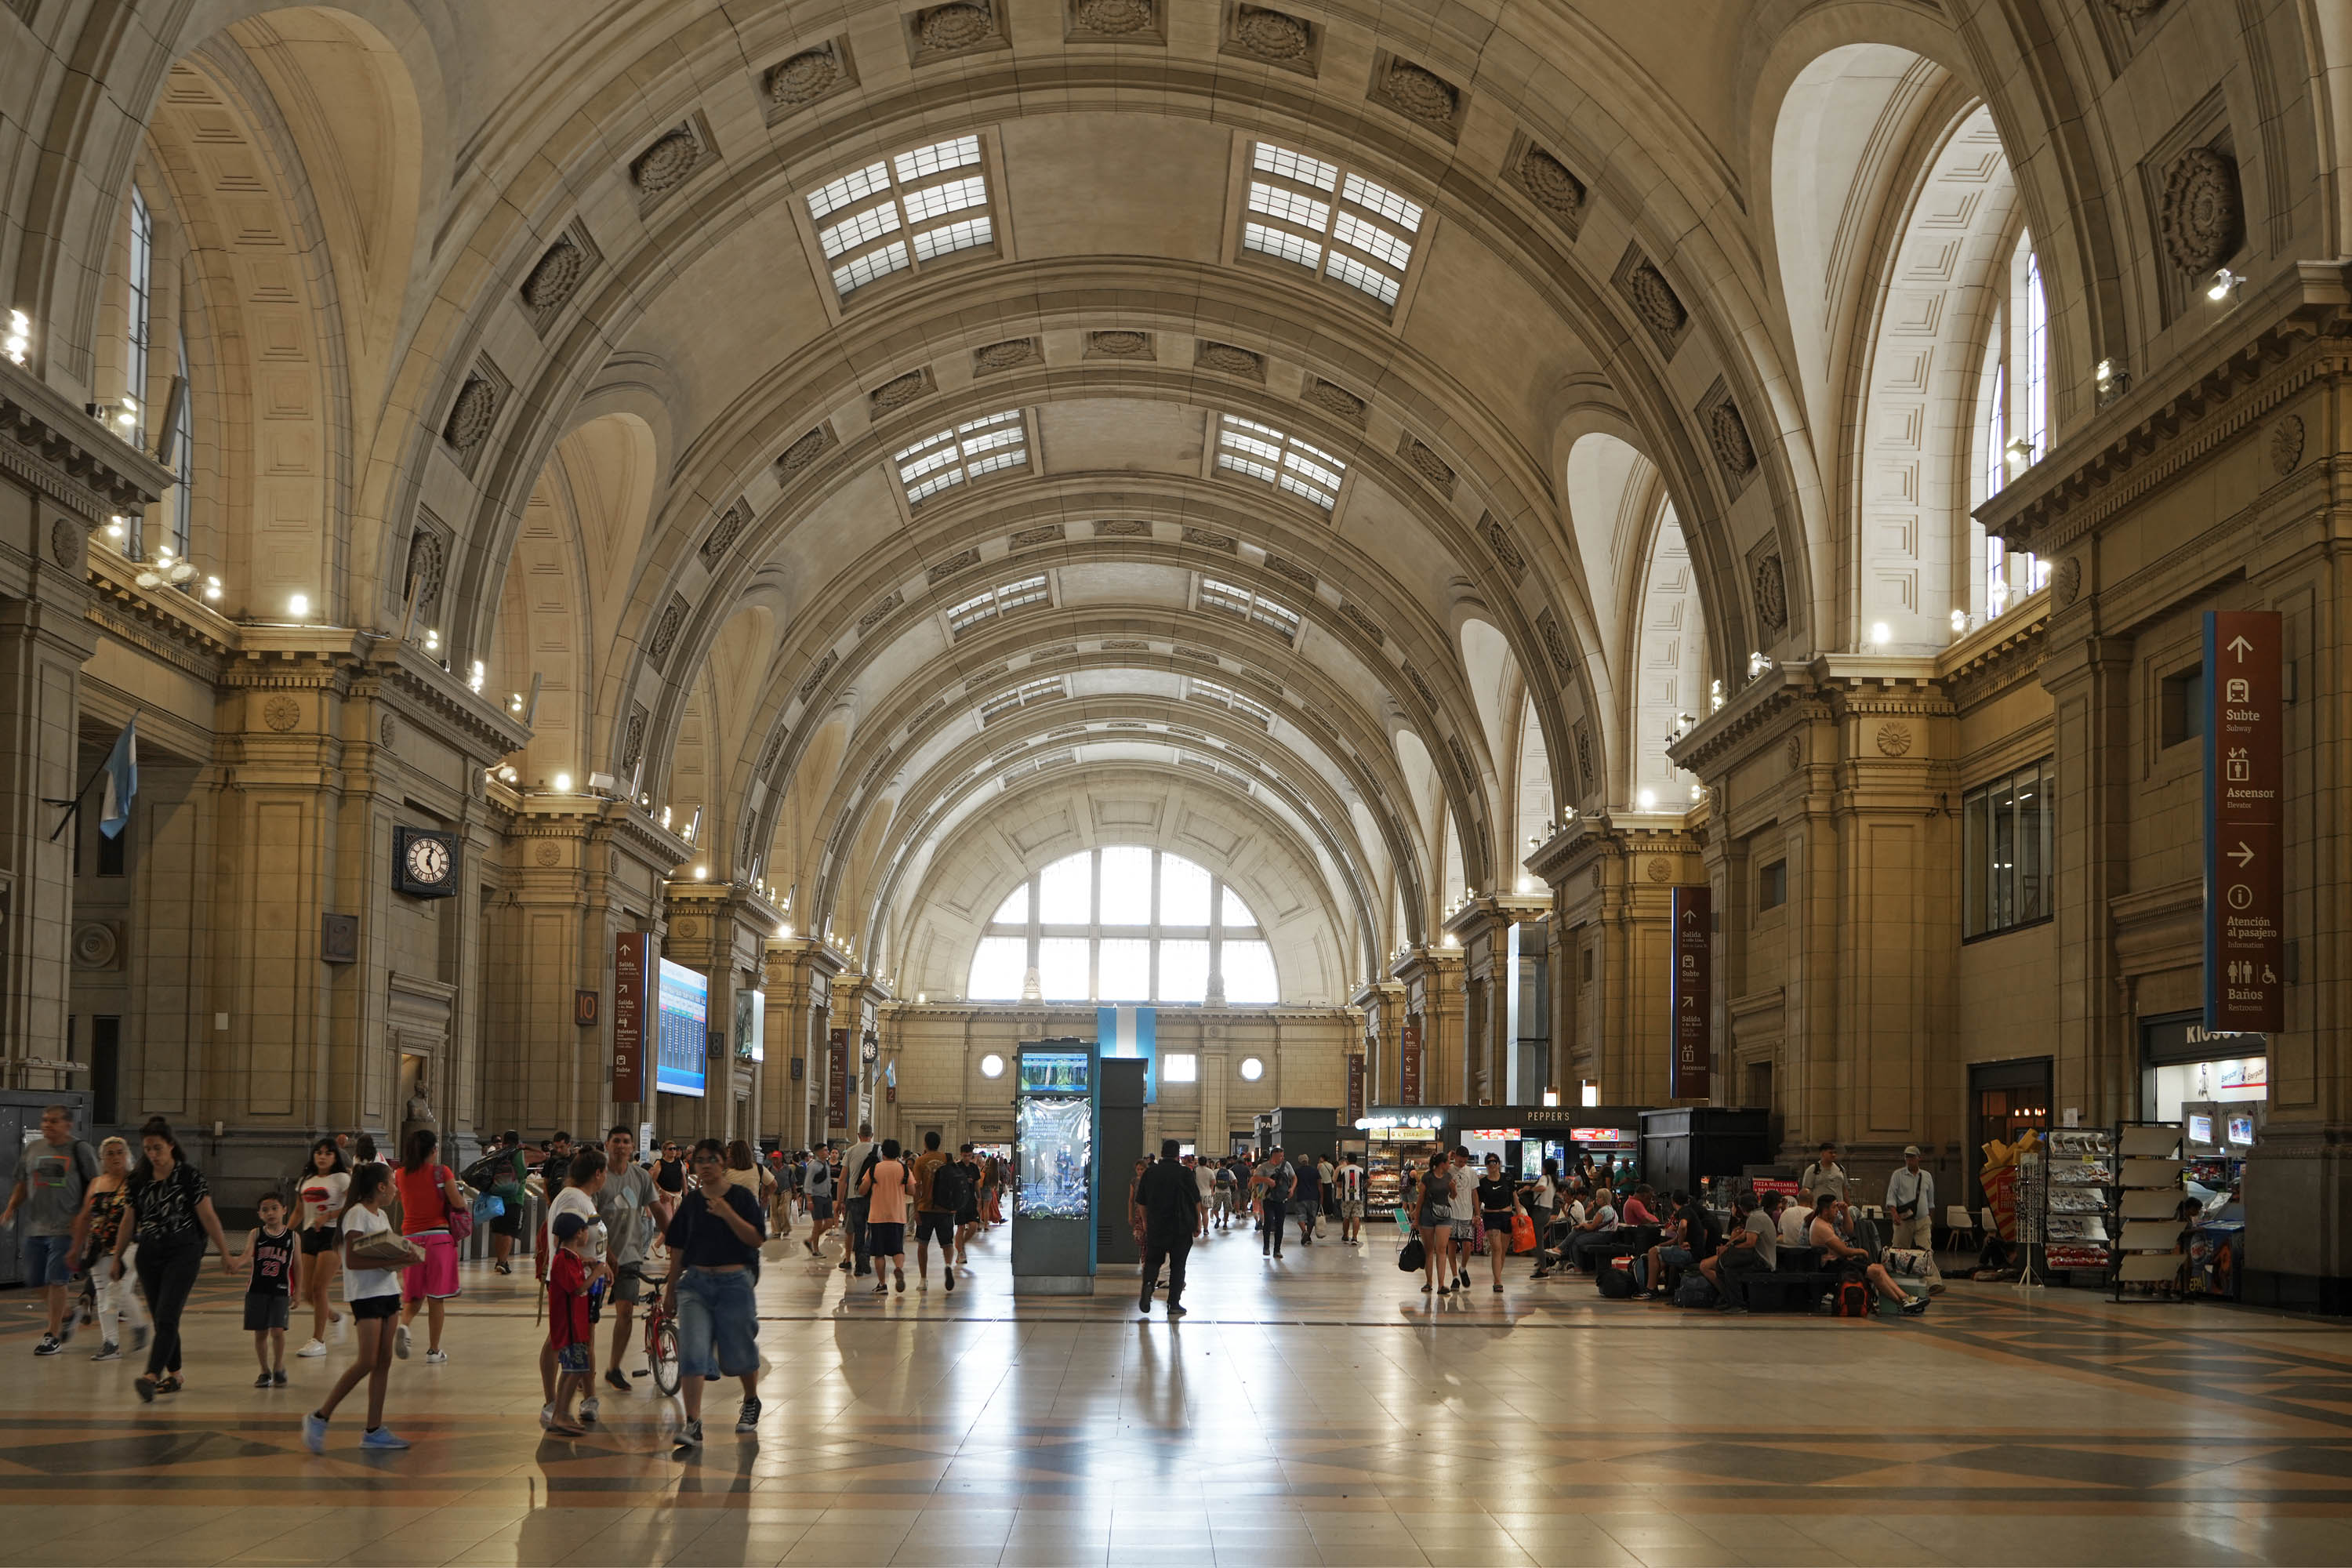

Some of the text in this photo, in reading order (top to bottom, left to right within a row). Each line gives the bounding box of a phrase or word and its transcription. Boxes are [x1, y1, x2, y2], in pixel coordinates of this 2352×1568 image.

[2227, 709, 2259, 720] Subte
[2227, 724, 2252, 733] Subway
[2227, 787, 2274, 798] Ascensor
[2227, 916, 2270, 927] Atención
[2227, 927, 2277, 939] al pasajero
[2227, 989, 2263, 1000] Baños
[580, 994, 595, 1018] 10
[712, 1036, 720, 1052] 8
[888, 1089, 894, 1100] 2
[1527, 1112, 1570, 1122] PEPPER'S
[257, 1246, 287, 1265] BULLS
[262, 1260, 280, 1277] 23
